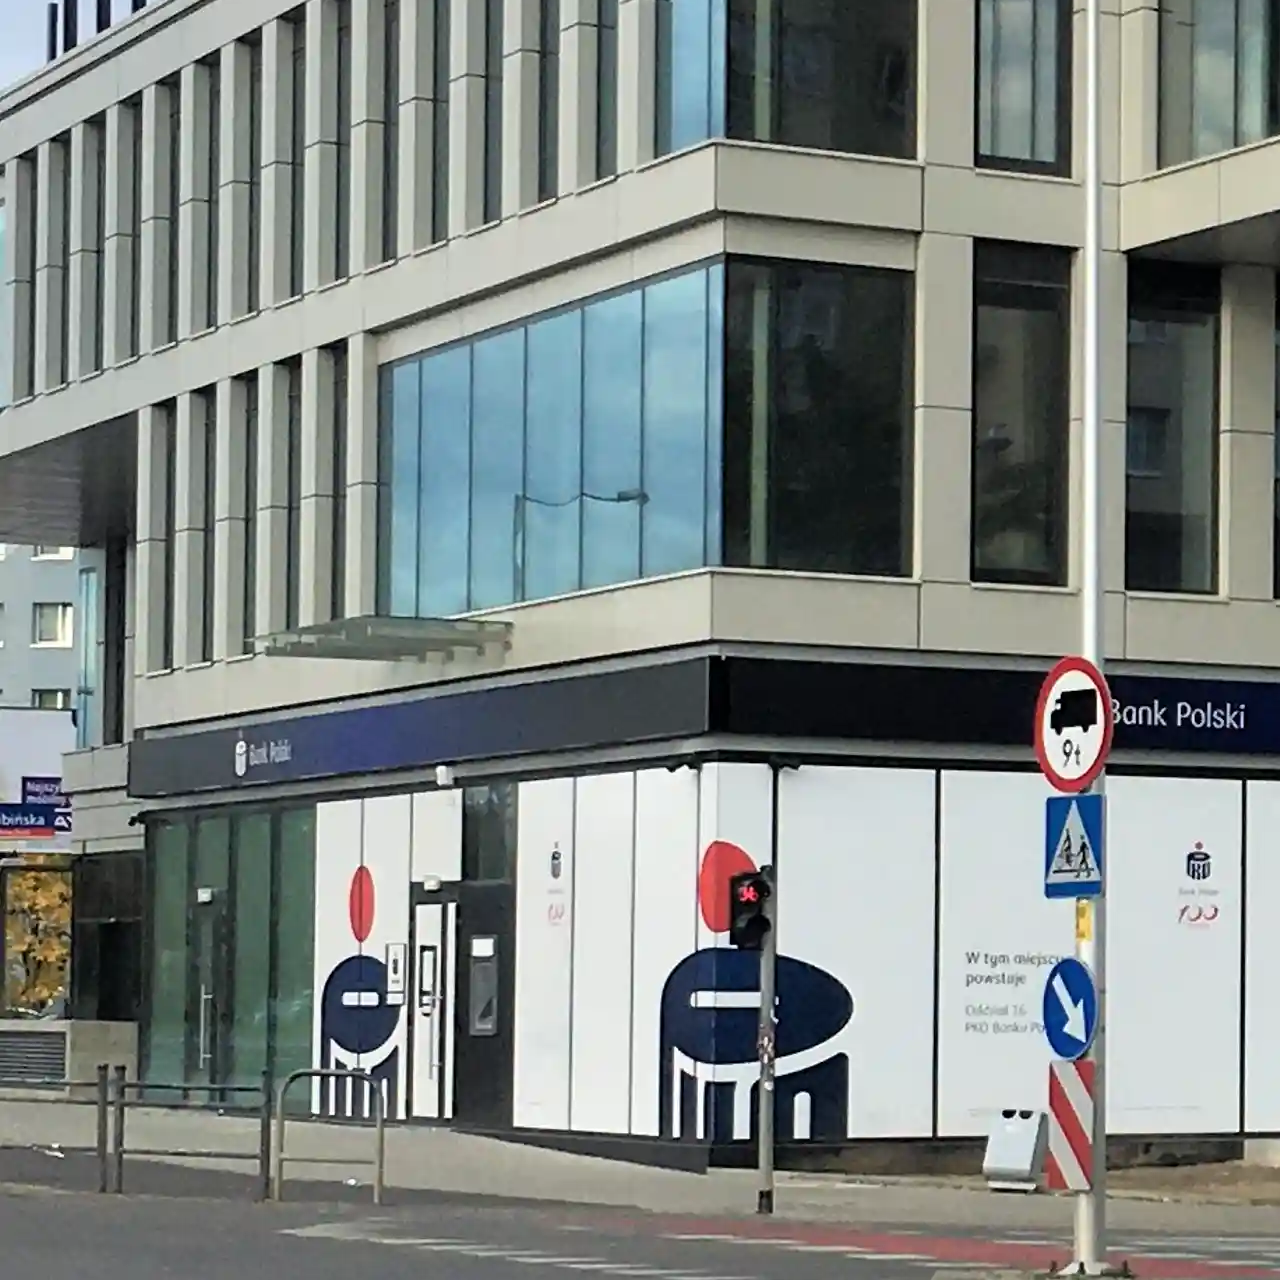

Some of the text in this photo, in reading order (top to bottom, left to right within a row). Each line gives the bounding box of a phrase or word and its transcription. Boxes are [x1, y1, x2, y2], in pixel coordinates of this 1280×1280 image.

[1177, 702, 1246, 729] Polski
[0, 812, 45, 826] bińska
[965, 951, 980, 965] W
[984, 953, 1011, 969] tym
